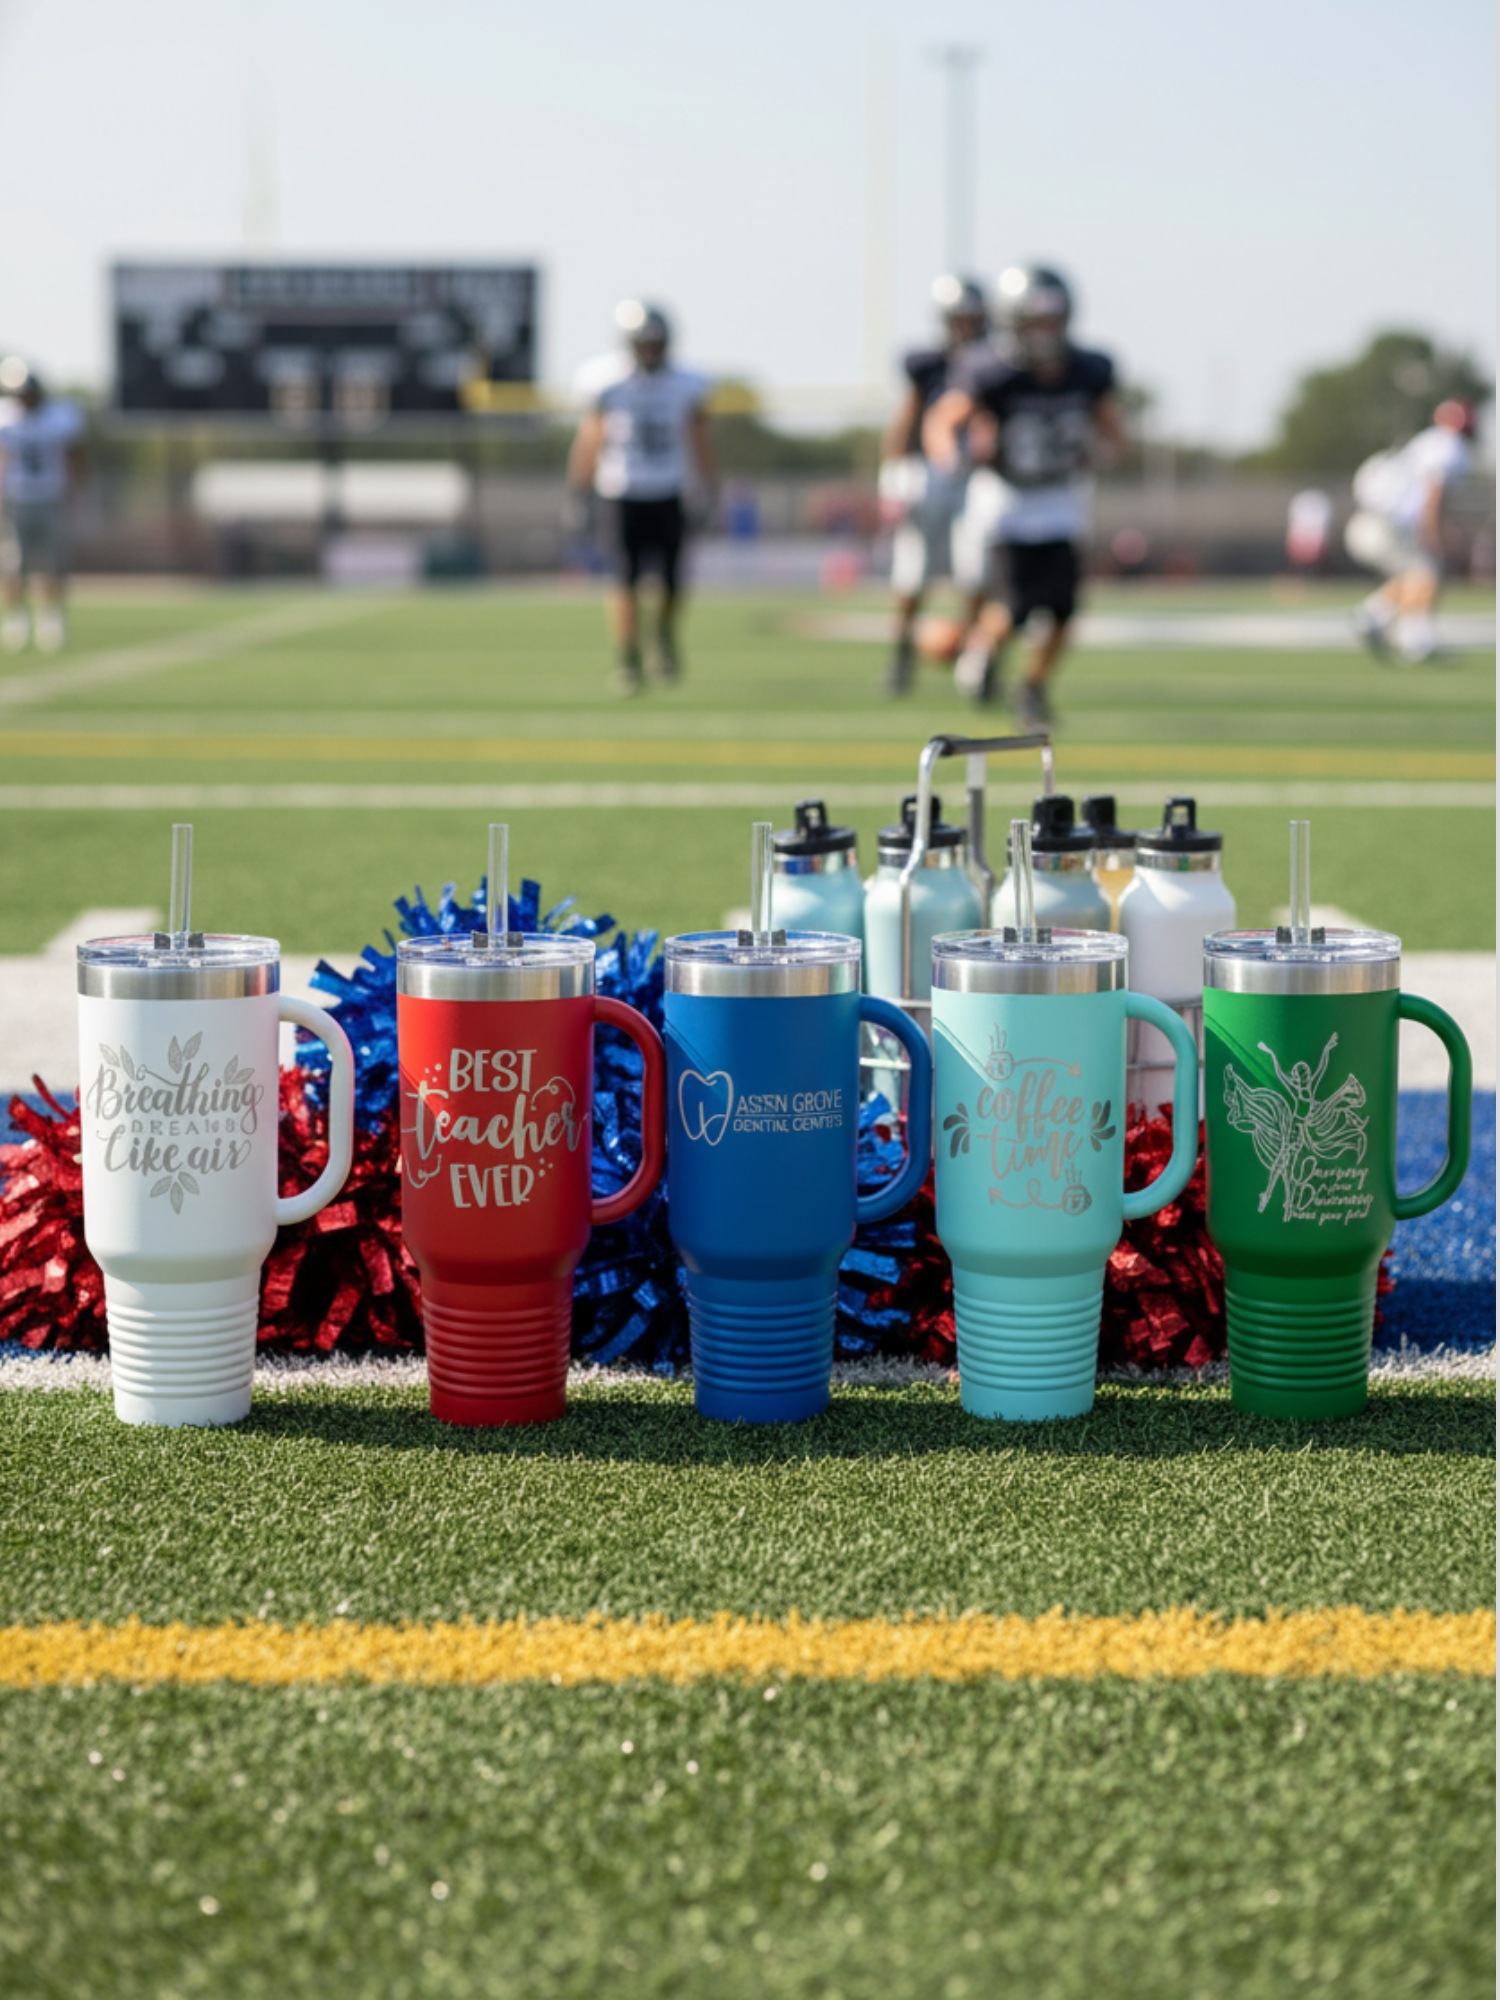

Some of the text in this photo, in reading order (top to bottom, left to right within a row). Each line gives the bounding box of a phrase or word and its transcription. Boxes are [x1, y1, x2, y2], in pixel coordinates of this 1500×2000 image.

[86, 1062, 265, 1134] Breathing
[449, 1047, 537, 1093] BEST
[401, 1079, 590, 1160] teacher
[792, 1088, 842, 1112] GROVE
[976, 1068, 1085, 1142] coffee
[96, 1124, 252, 1177] Like air
[975, 1123, 1084, 1182] time
[449, 1163, 535, 1208] EVER
